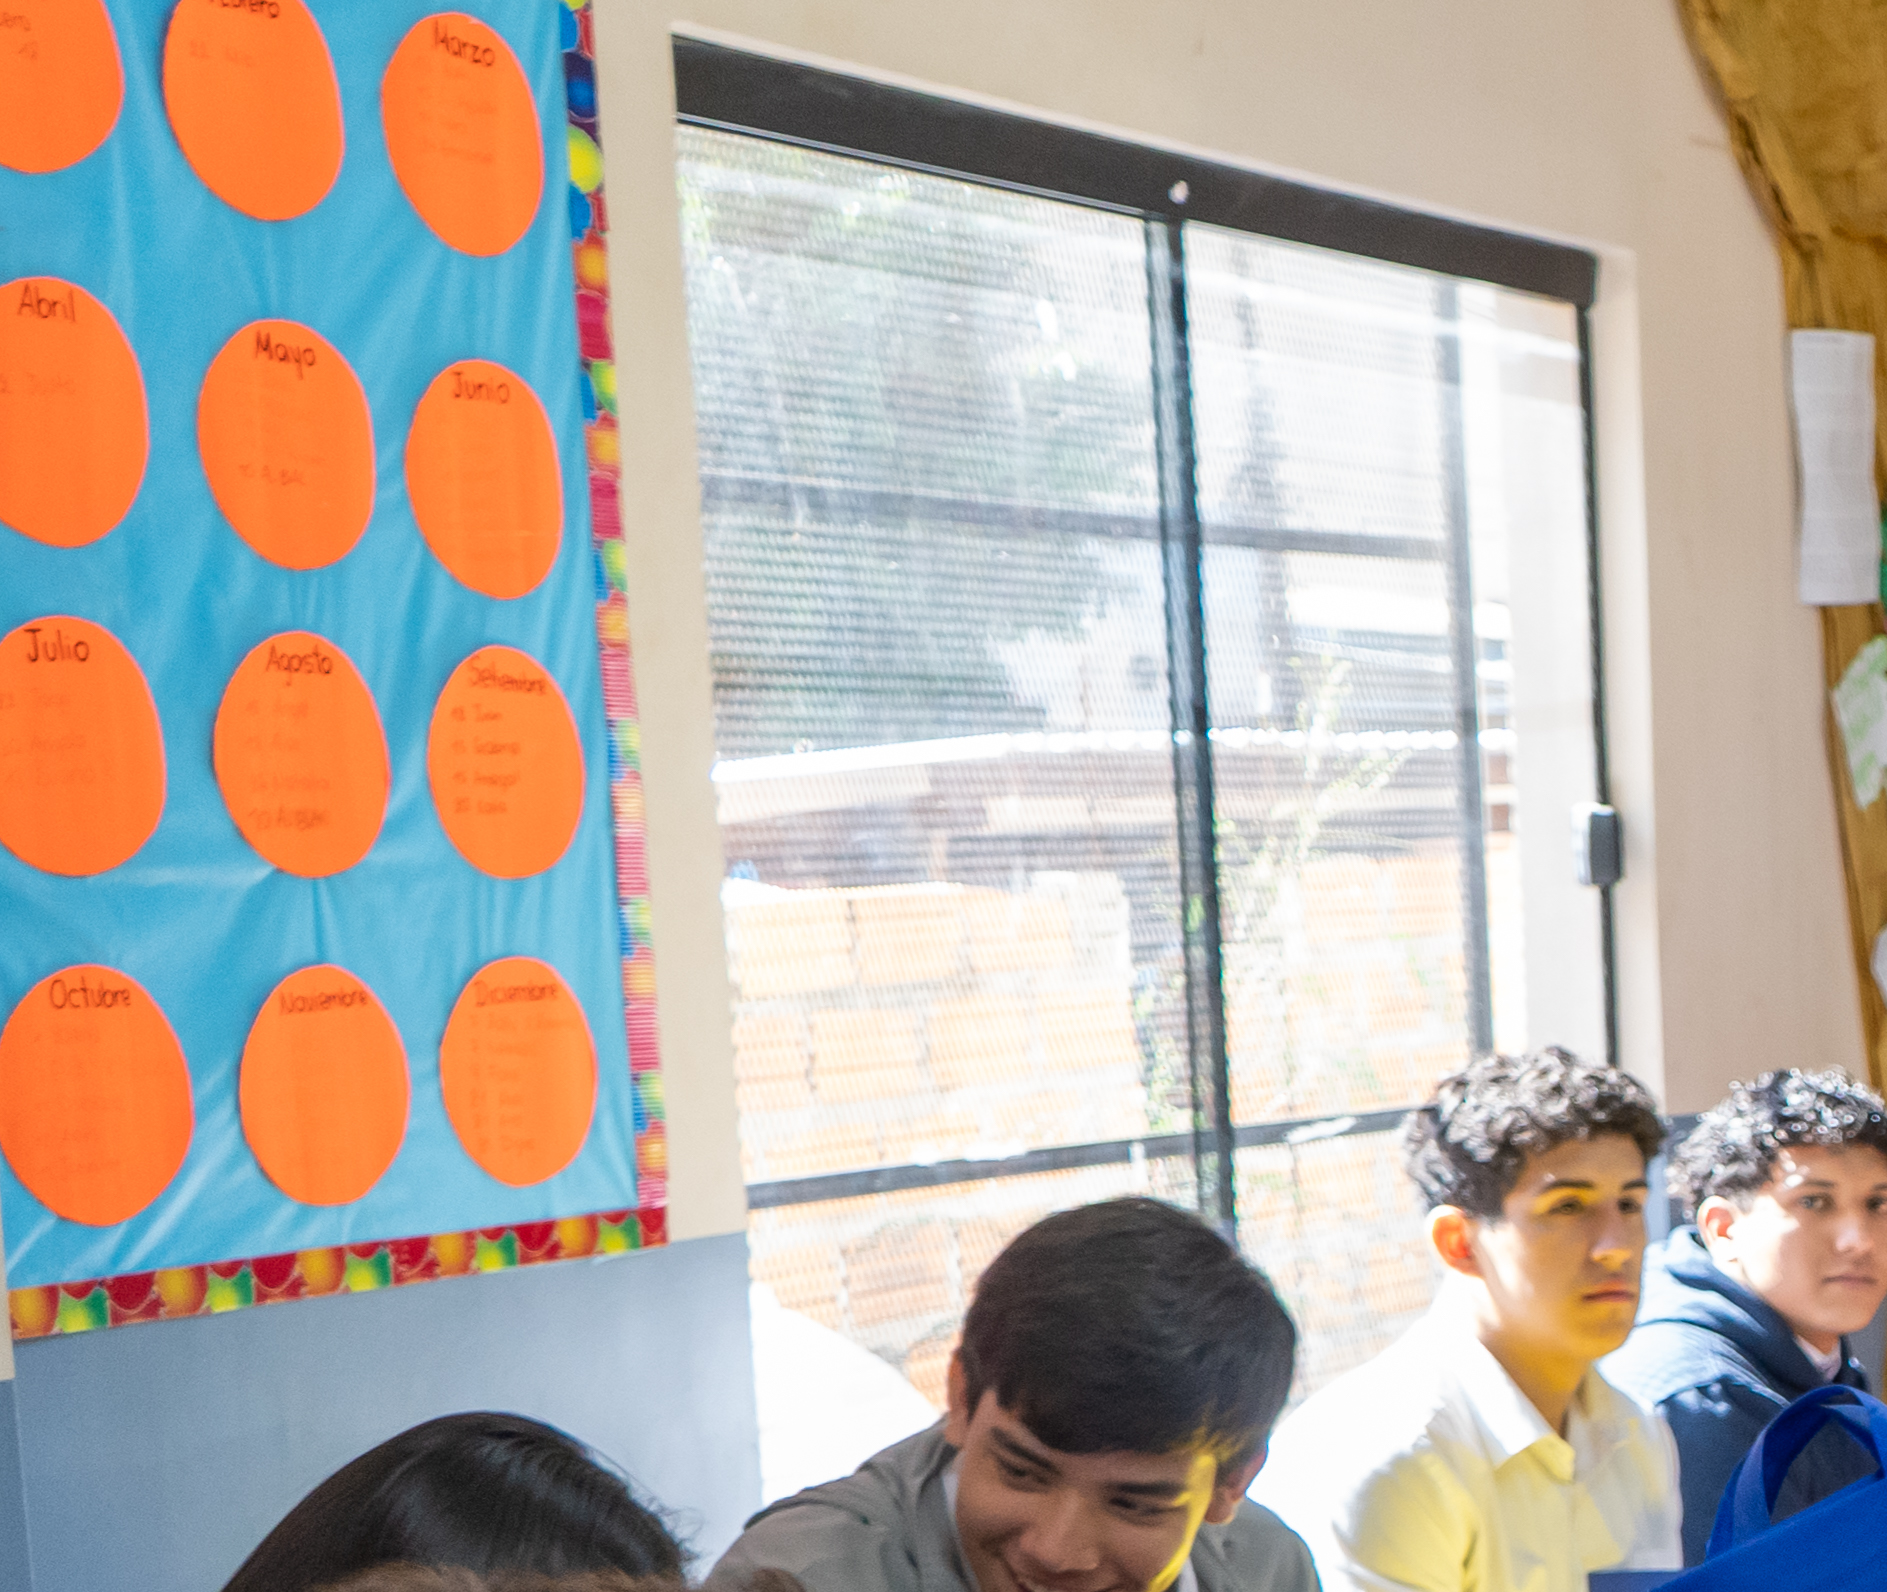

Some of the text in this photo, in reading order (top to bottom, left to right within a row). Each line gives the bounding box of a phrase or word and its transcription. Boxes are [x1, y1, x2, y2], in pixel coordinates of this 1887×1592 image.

[432, 20, 496, 68] Marzo
[17, 287, 77, 324] Abril
[254, 331, 317, 380] Mayo
[451, 370, 512, 406] Junio
[24, 627, 91, 665] Julio
[265, 644, 334, 687] Agosto
[50, 976, 133, 1012] Octubre
[278, 988, 370, 1018] Noviembre
[473, 979, 560, 1009] Diciembre
